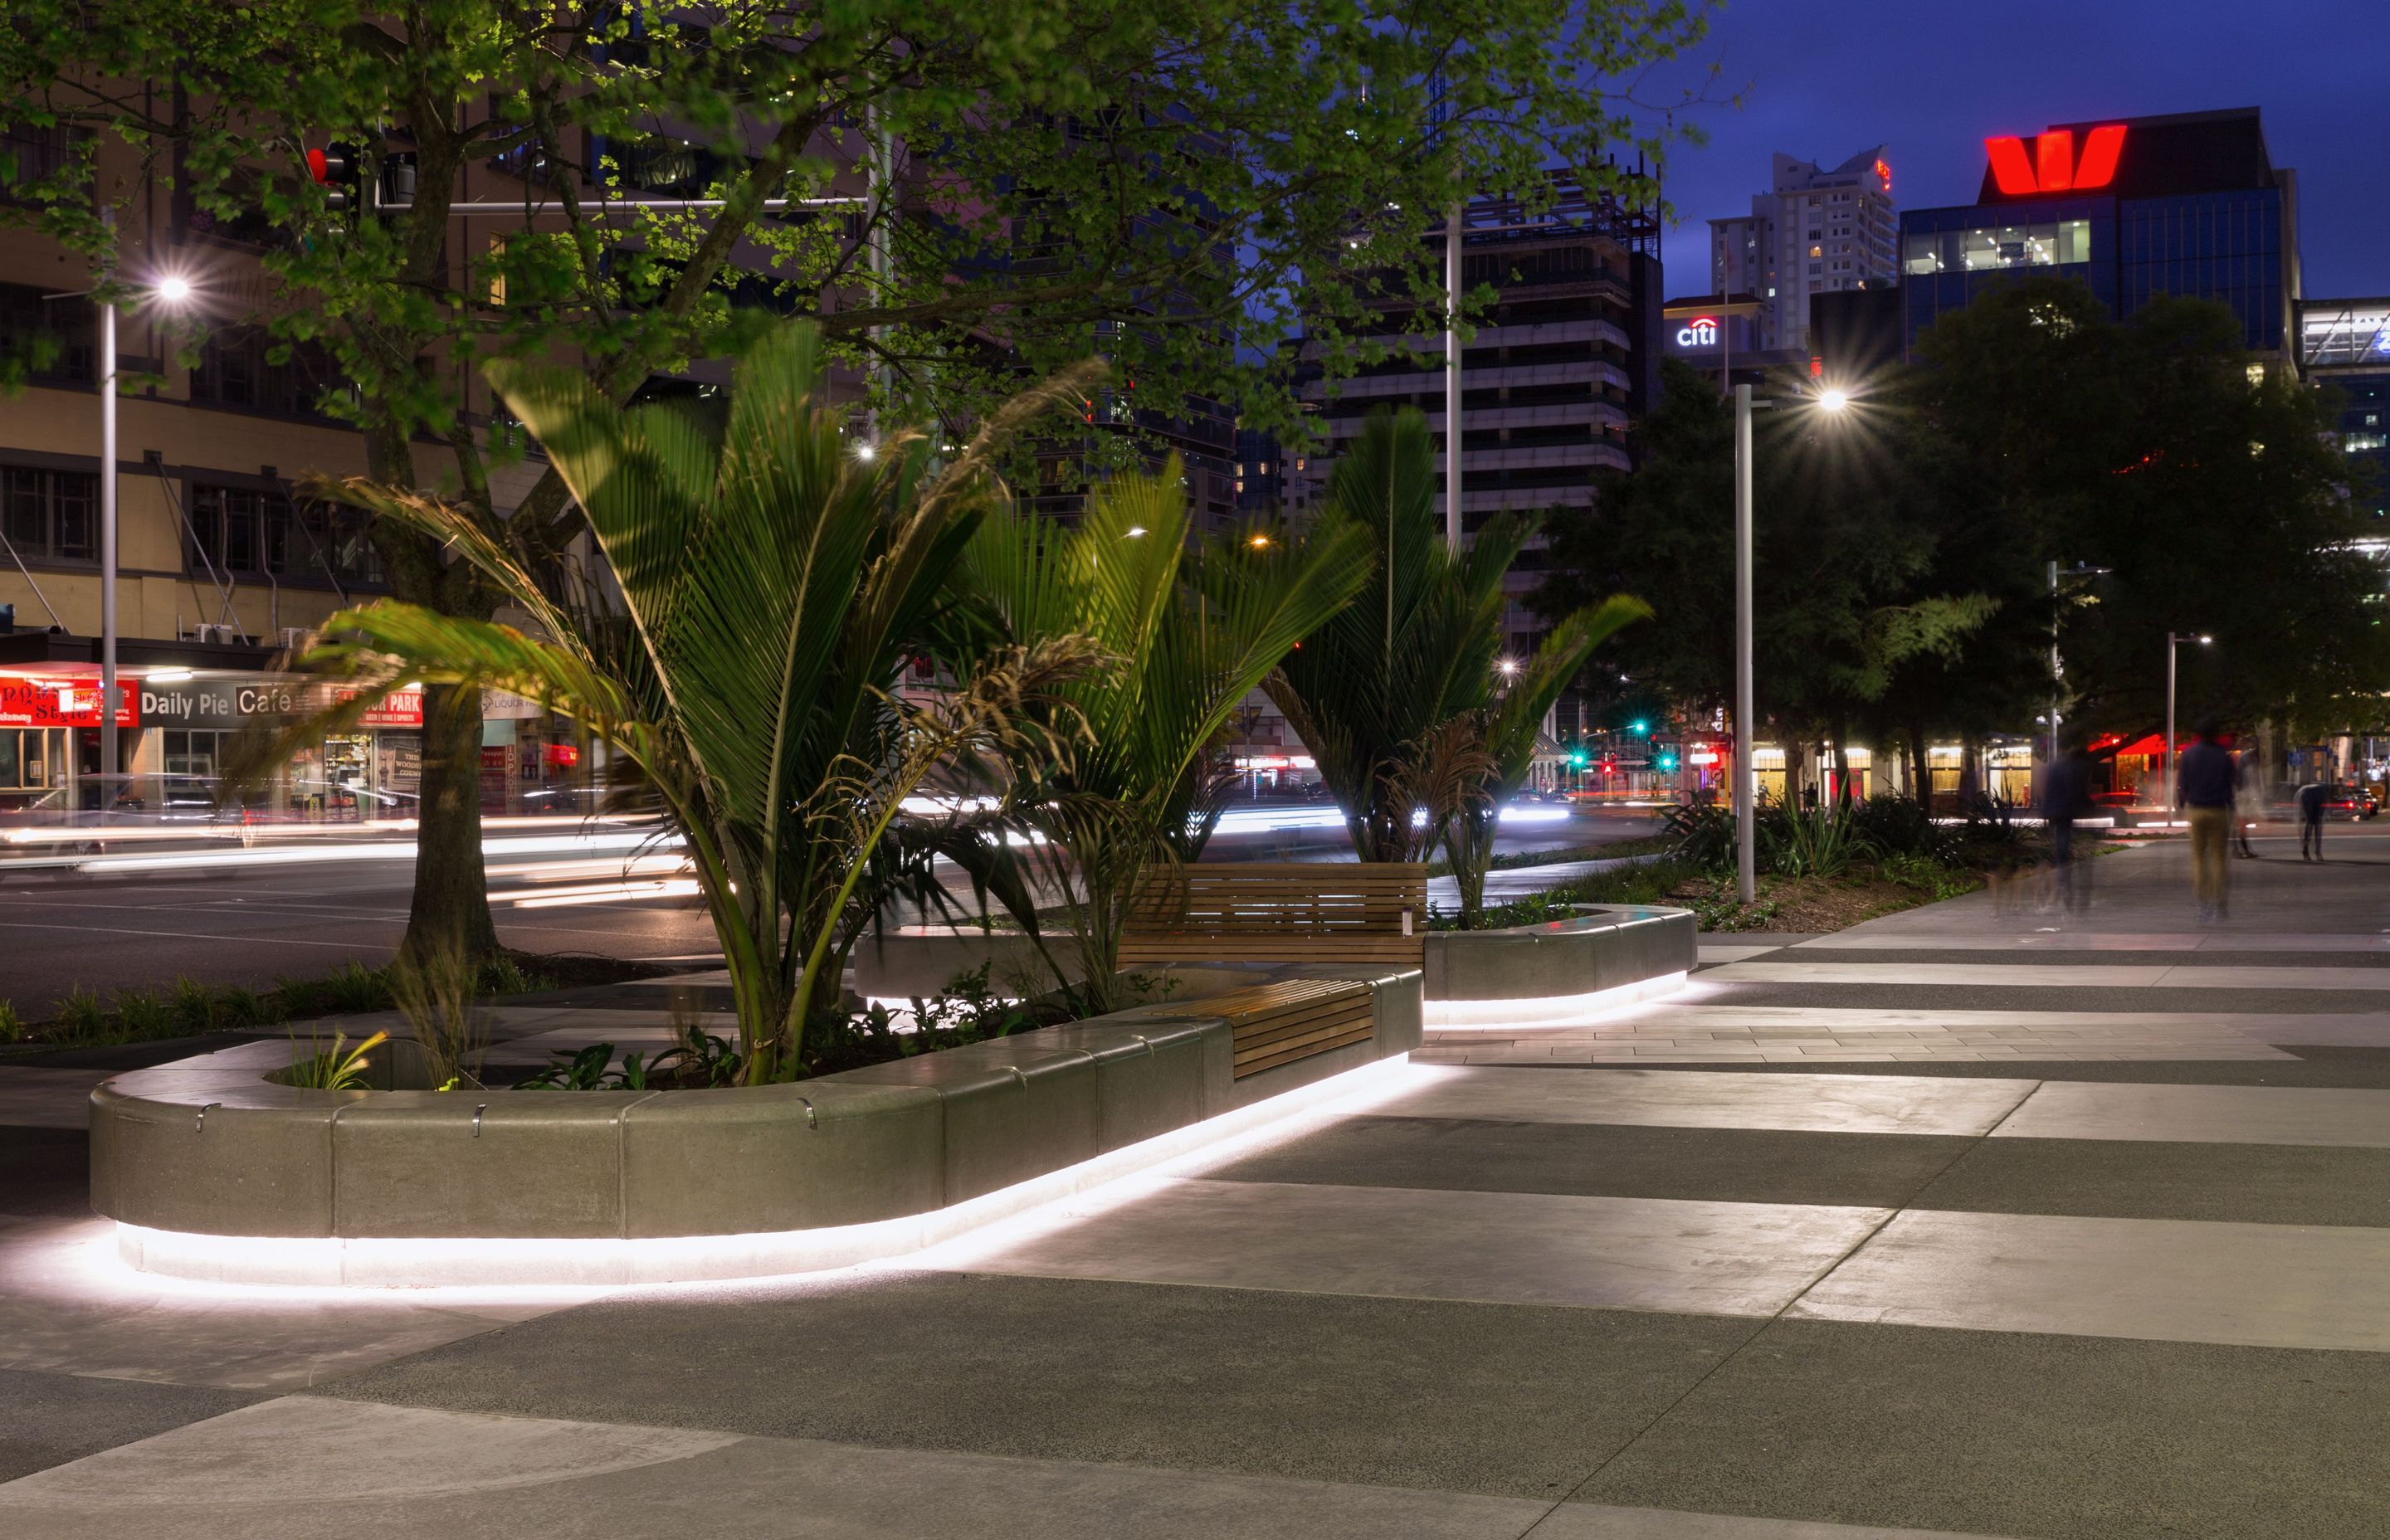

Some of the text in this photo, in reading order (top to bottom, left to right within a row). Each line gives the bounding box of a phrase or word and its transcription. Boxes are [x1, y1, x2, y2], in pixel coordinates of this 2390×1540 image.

[1677, 324, 1715, 346] citi
[142, 692, 193, 719] Daily
[200, 693, 228, 715] Pie
[239, 688, 290, 714] Café
[390, 694, 420, 712] PARK
[495, 699, 524, 709] LIQUOR
